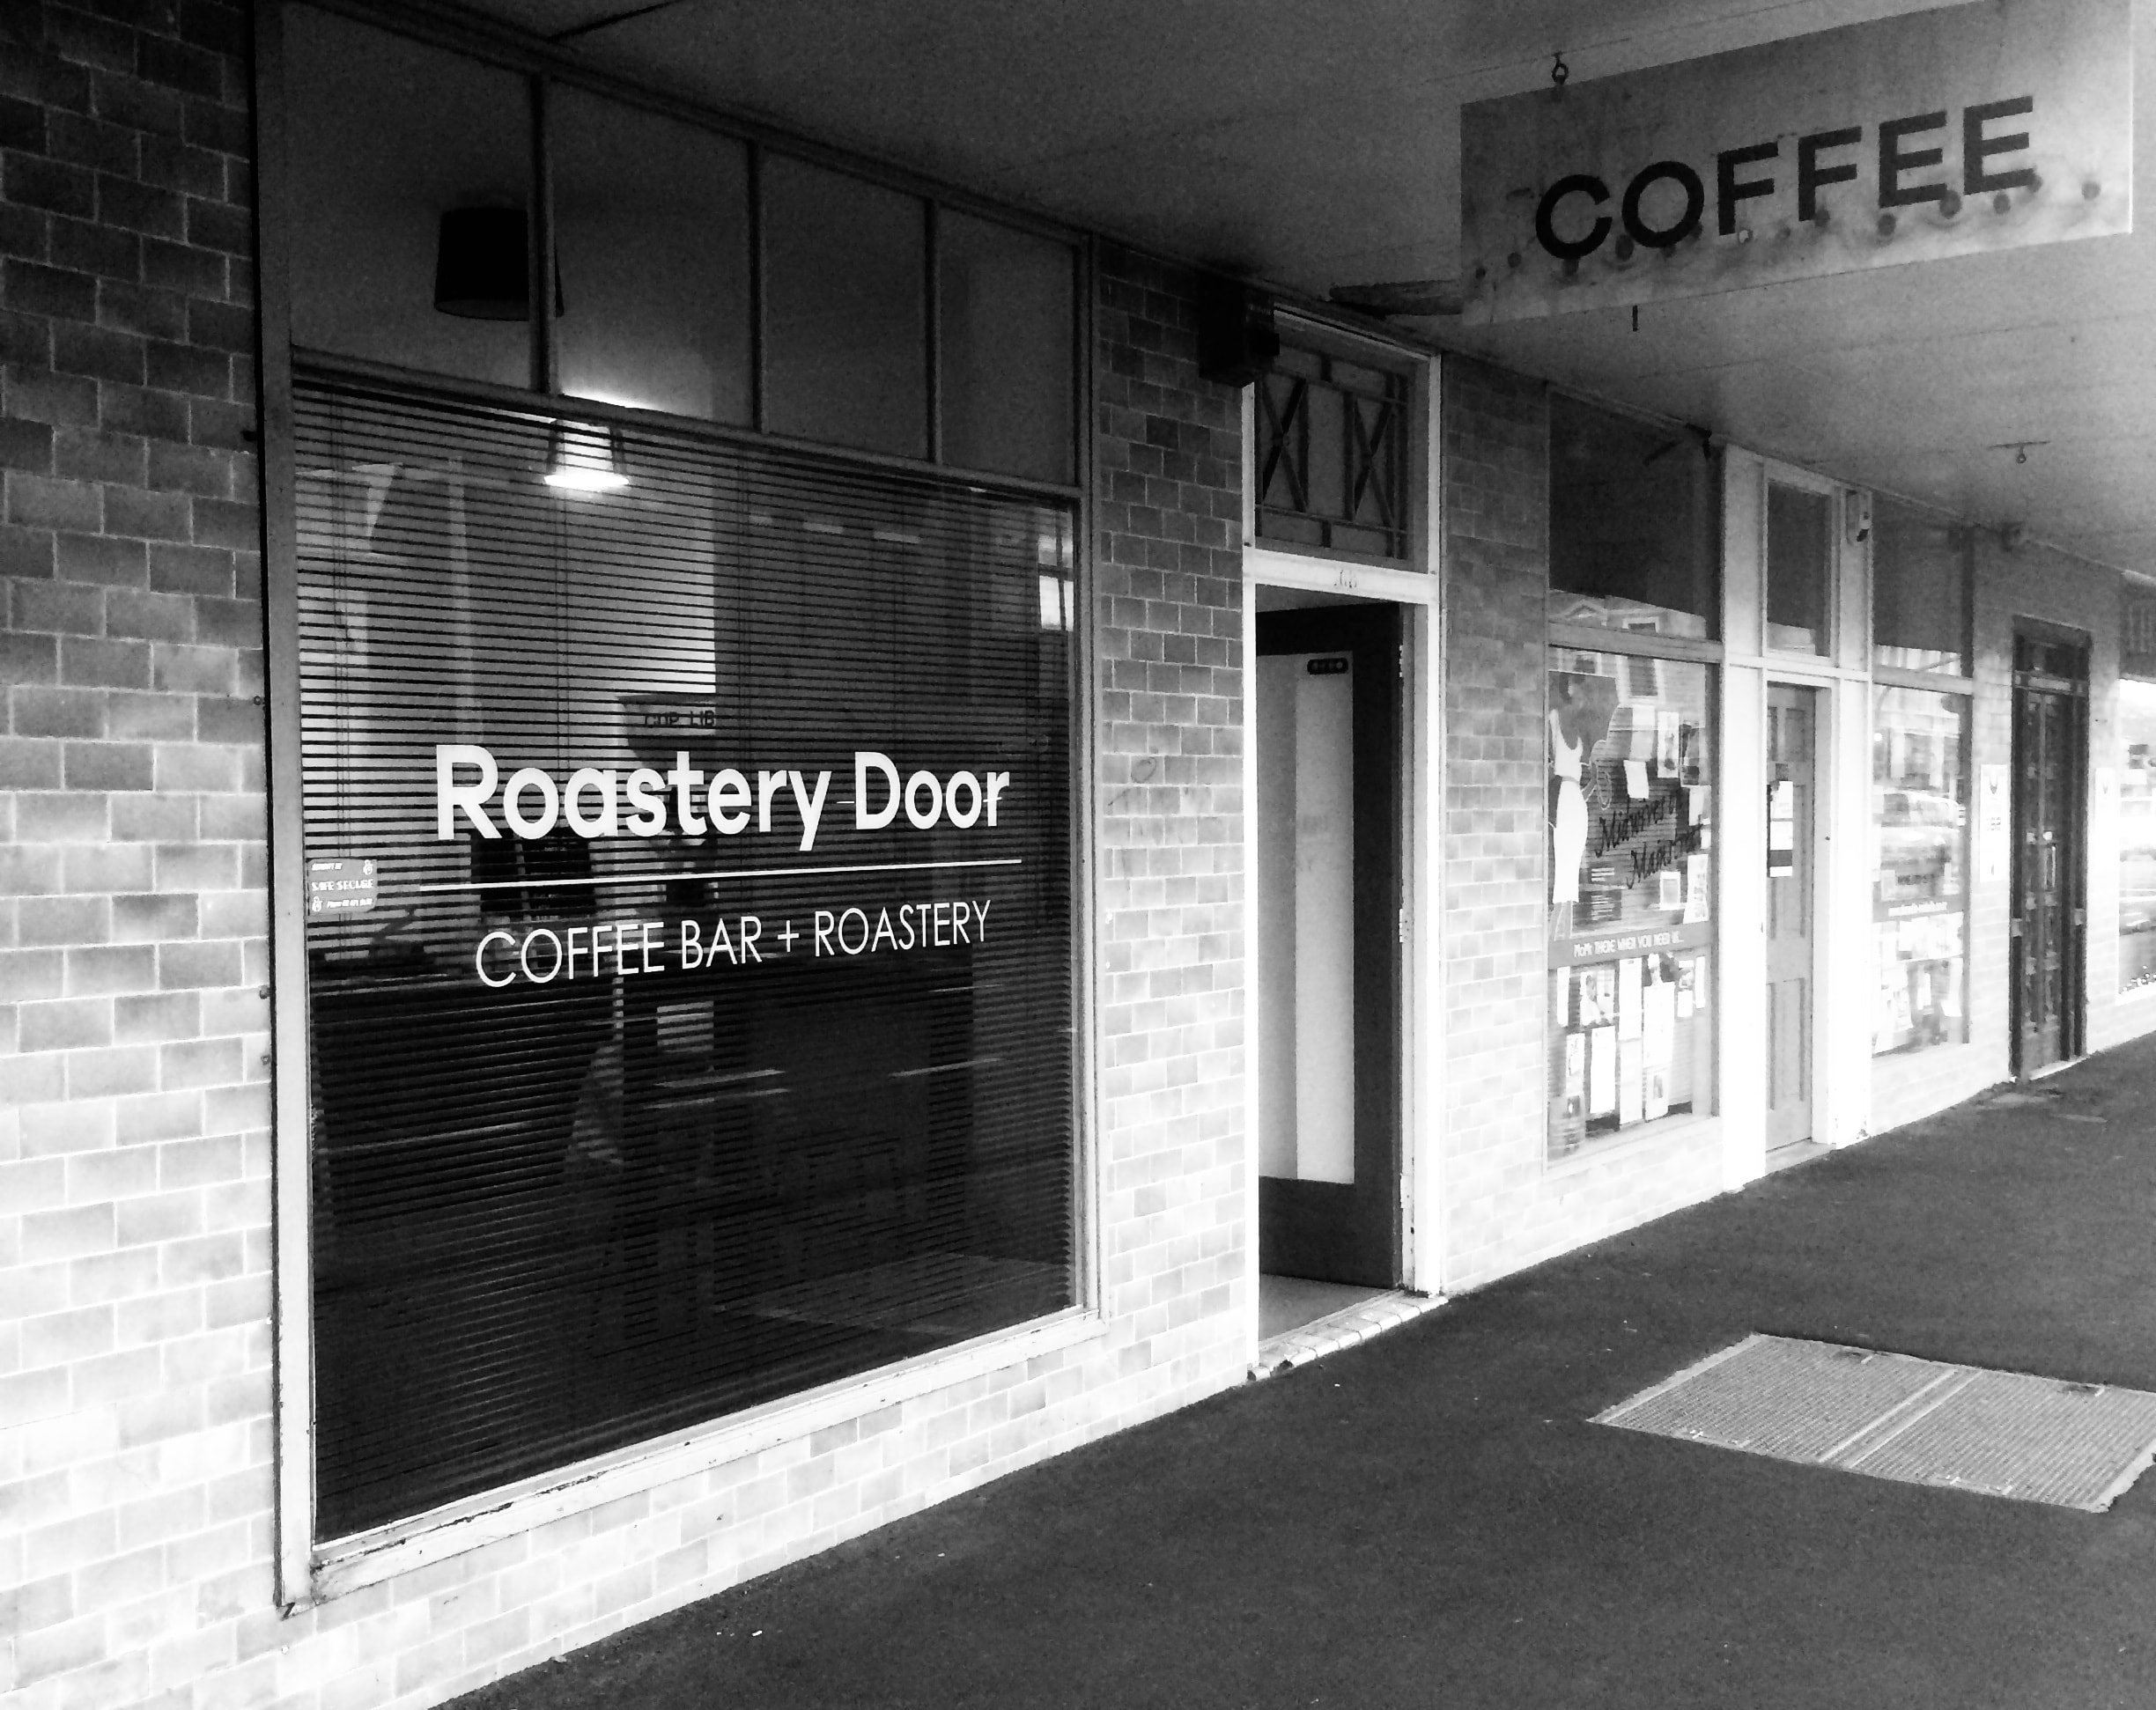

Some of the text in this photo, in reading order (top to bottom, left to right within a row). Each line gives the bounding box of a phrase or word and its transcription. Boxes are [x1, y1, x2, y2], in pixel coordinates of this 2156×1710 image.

[1535, 95, 2034, 260] COFFEE
[436, 744, 1011, 851] Roastery Door
[476, 919, 665, 988] COFFEE
[681, 916, 763, 969] BAR
[815, 899, 992, 957] ROASTERY
